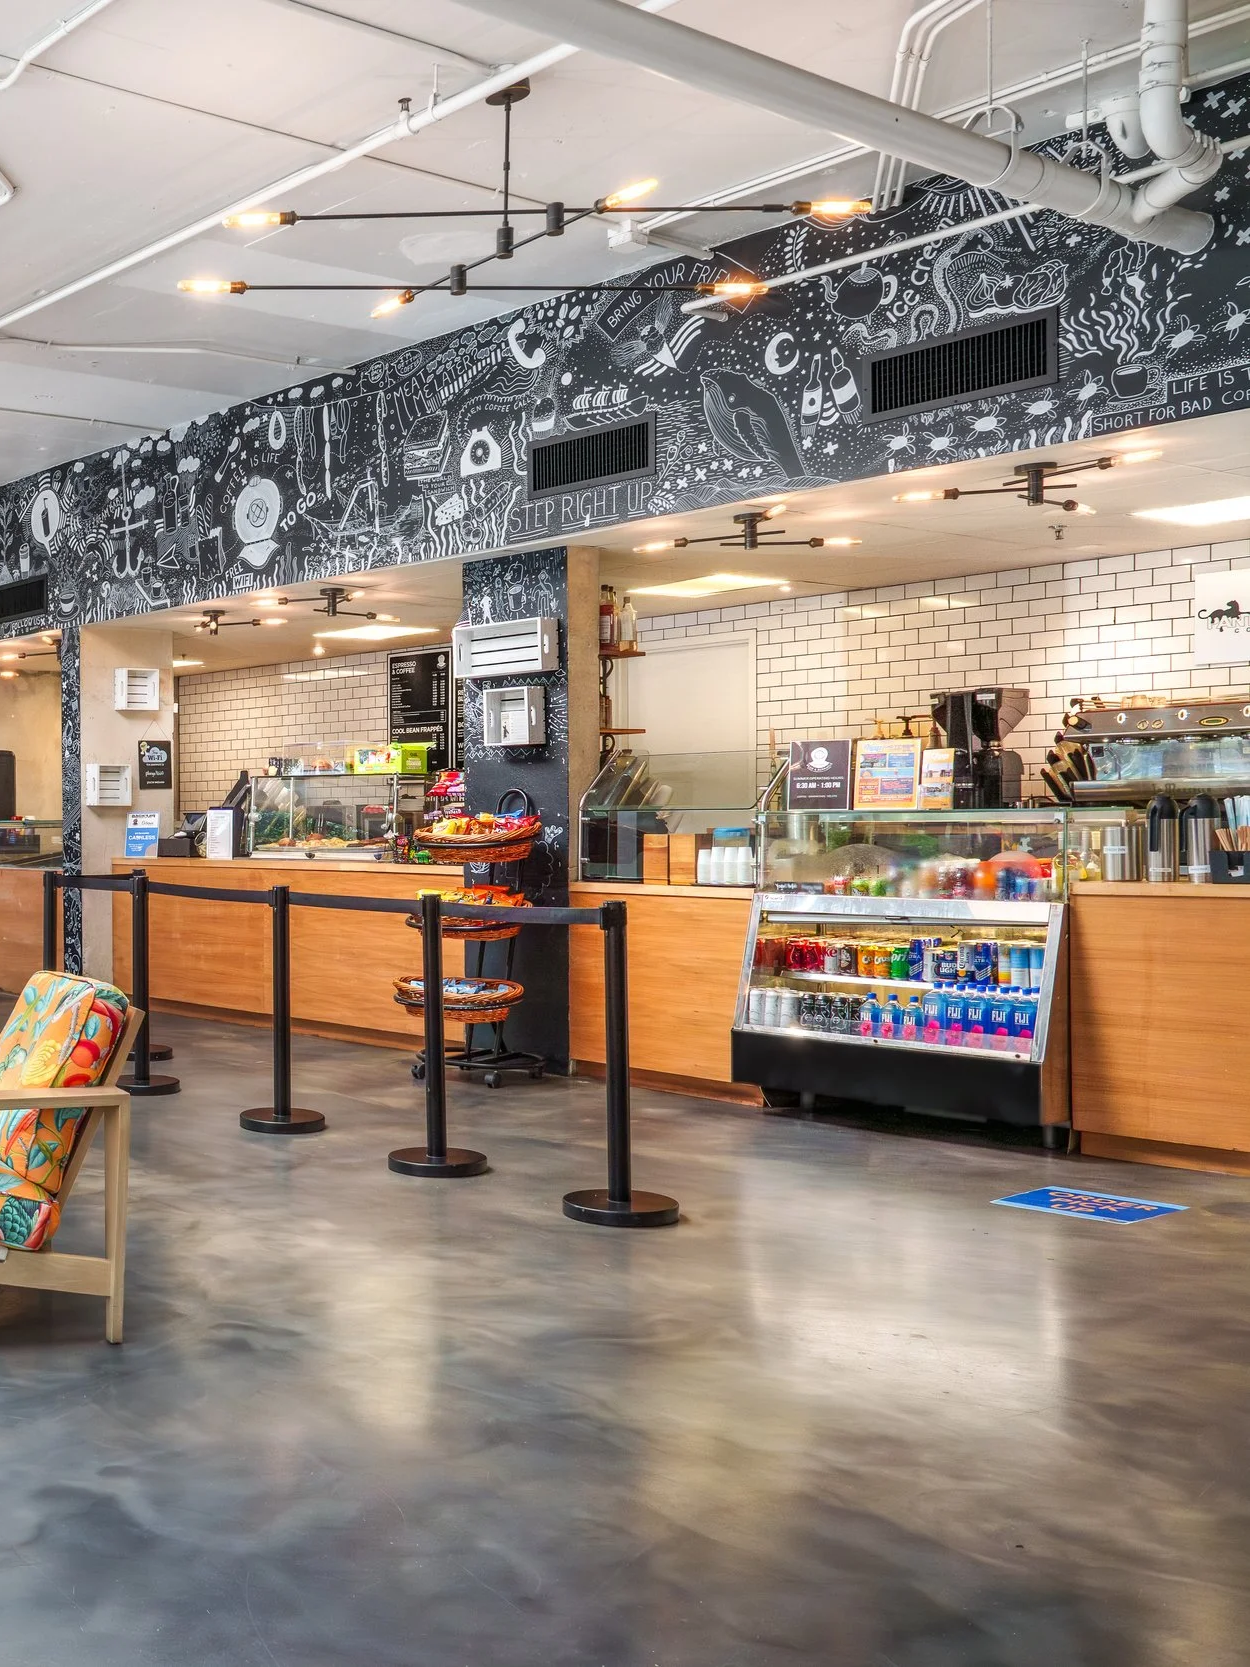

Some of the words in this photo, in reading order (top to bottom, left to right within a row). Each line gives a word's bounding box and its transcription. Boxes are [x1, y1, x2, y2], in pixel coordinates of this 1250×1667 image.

[607, 289, 642, 328] BRING
[644, 262, 685, 295] YOUR
[1172, 374, 1208, 395] LIFE
[1218, 370, 1235, 388] IS
[413, 383, 433, 417] ME
[484, 403, 510, 413] COFFEE
[1093, 411, 1144, 432] SHORT
[1149, 405, 1177, 422] FOR
[1181, 396, 1212, 416] BAD
[220, 464, 246, 514] COFFEE
[250, 454, 259, 467] IS
[261, 452, 281, 465] LIFE
[279, 511, 297, 532] TO
[296, 491, 317, 515] GO
[509, 500, 555, 533] STEP
[561, 485, 621, 523] RIGHT
[627, 481, 653, 512] UP
[225, 560, 244, 582] FREE
[392, 660, 417, 669] ESPRESSO
[395, 667, 416, 675] COFFEE
[406, 726, 420, 734] BEAN
[924, 1003, 938, 1015] FIJI
[947, 1006, 962, 1018] FIJI
[968, 1007, 982, 1020] FIJI
[991, 1010, 1006, 1022] FIJI
[1014, 1012, 1029, 1024] FIJI
[1048, 1191, 1159, 1211] ORDER
[1050, 1197, 1127, 1212] PICK
[1050, 1203, 1095, 1212] UP
